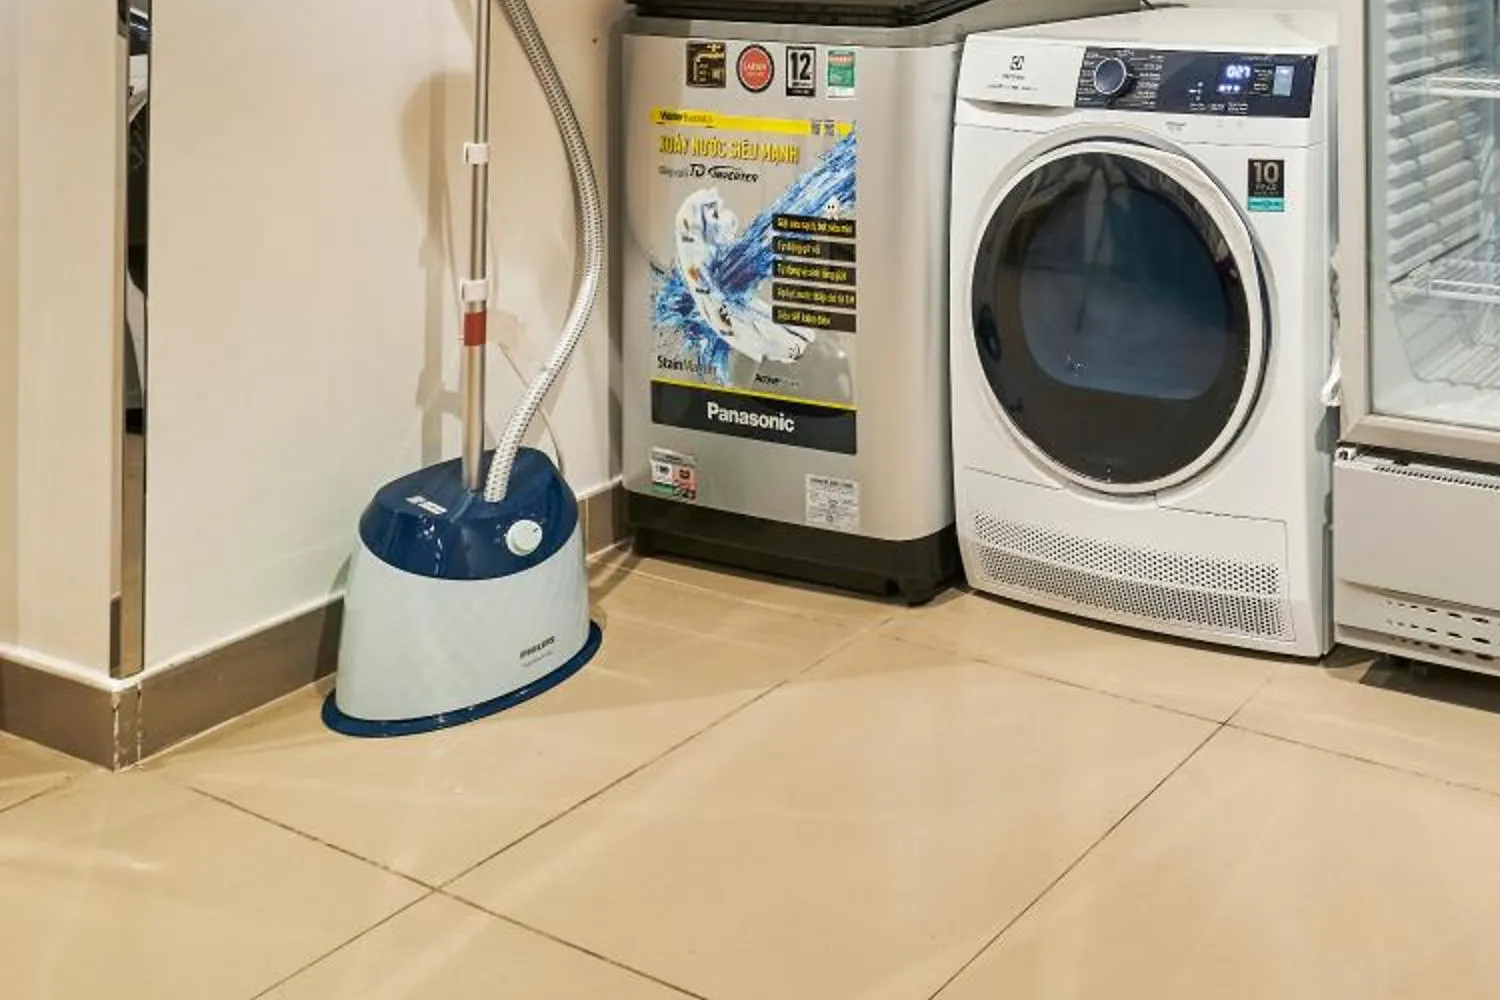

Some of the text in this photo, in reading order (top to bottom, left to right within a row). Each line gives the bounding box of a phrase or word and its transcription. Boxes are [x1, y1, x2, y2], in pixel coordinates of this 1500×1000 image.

[790, 51, 811, 81] 12
[1253, 161, 1280, 184] 10
[707, 401, 795, 433] Panasonic
